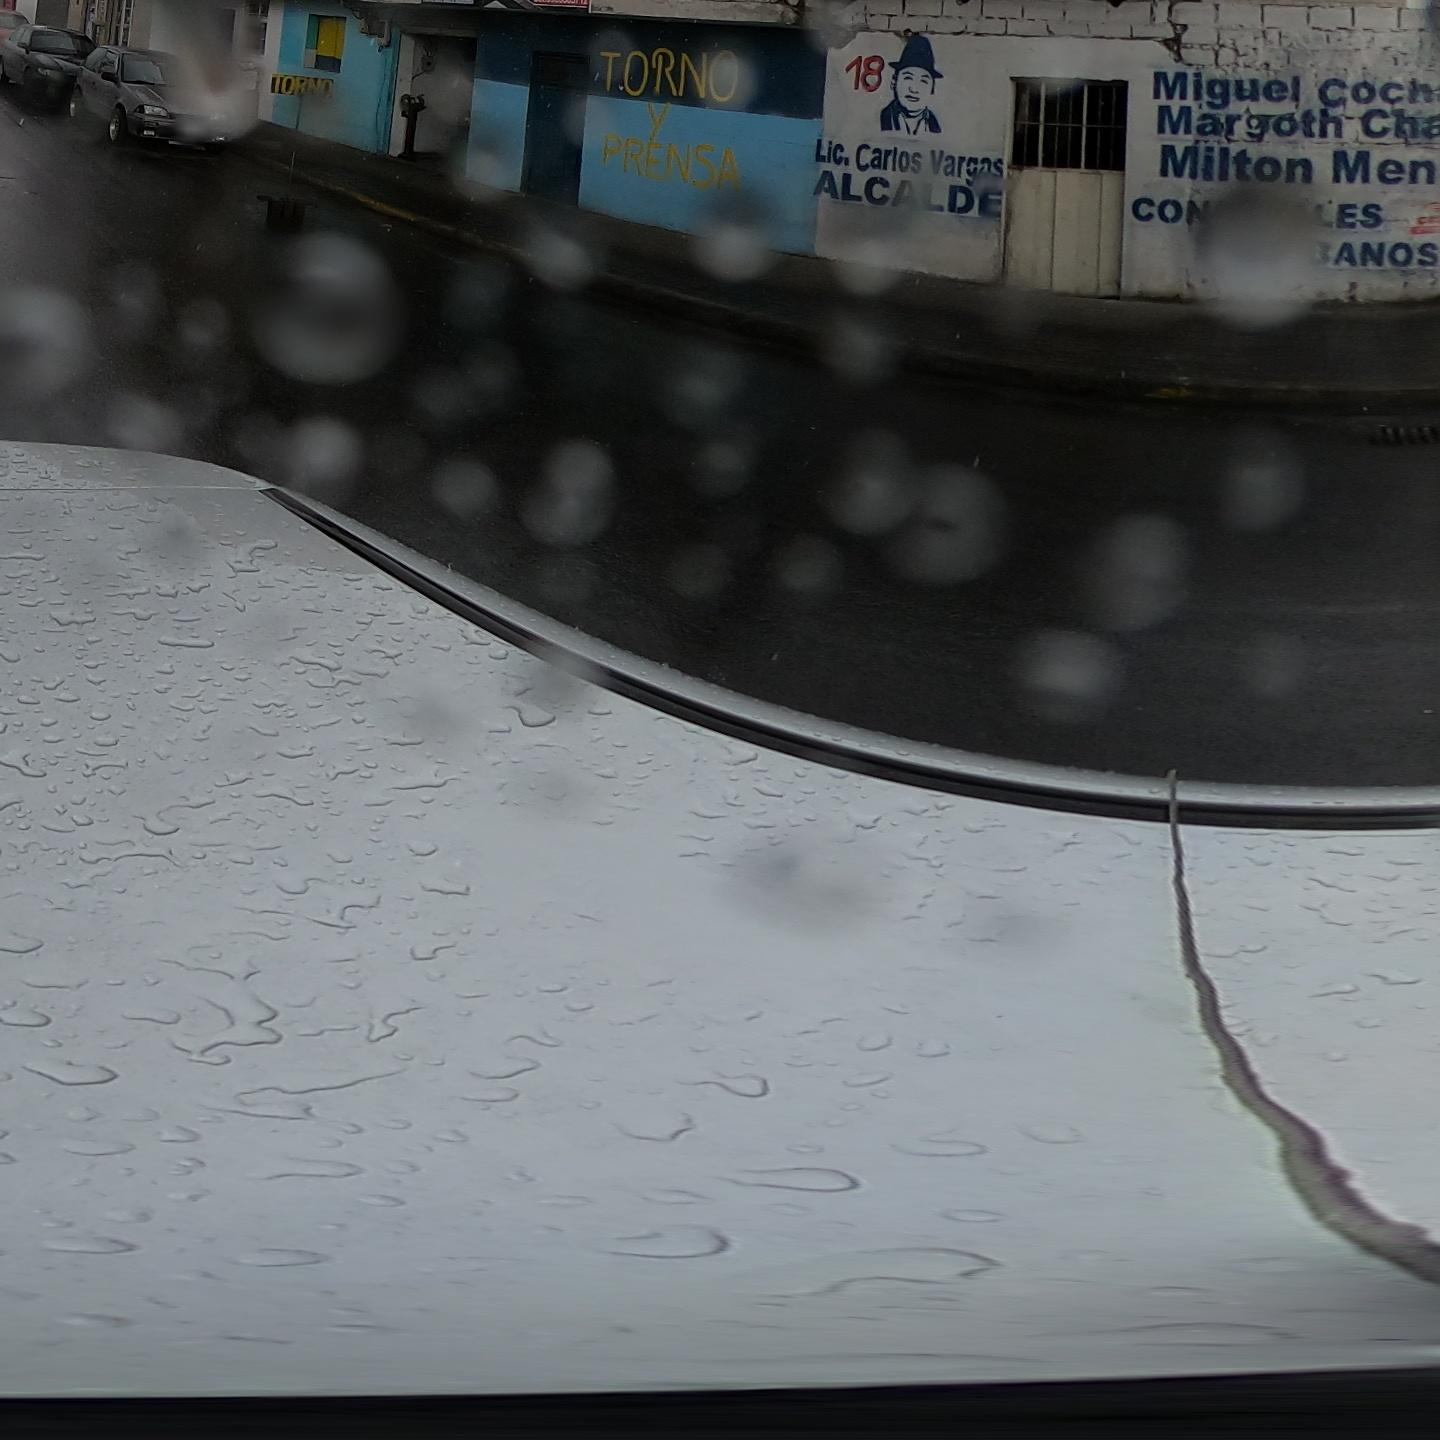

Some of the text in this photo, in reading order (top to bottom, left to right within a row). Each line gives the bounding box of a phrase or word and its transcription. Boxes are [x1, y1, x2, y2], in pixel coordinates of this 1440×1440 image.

[273, 75, 335, 97] TORNO
[600, 48, 739, 102] TORNO
[845, 55, 885, 92] 18
[1153, 71, 1300, 110] Miguel
[647, 102, 670, 143] Y
[1157, 105, 1344, 140] Margoth
[602, 133, 740, 191] PRENSA
[815, 138, 1004, 186] Lic. Carlos Vargas
[1160, 144, 1436, 185] Milton Men
[813, 170, 1002, 217] ALCALDE
